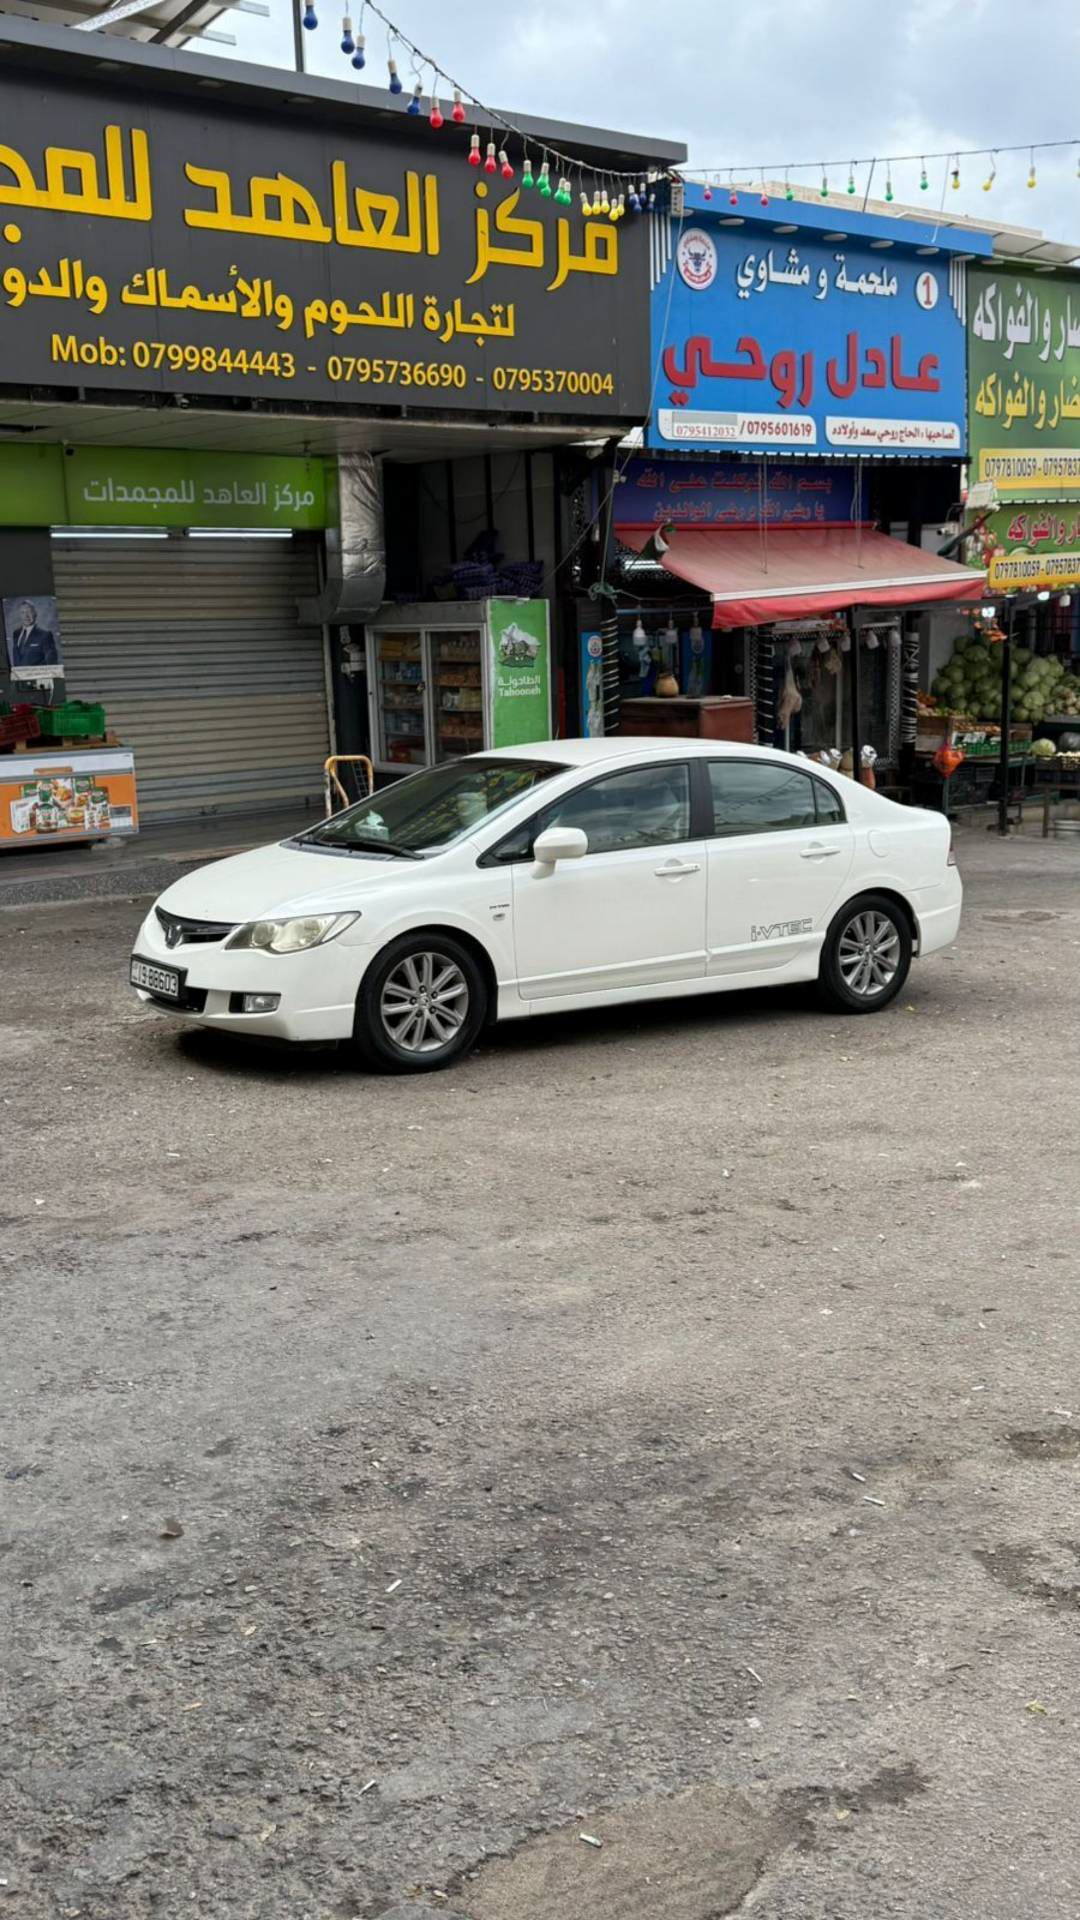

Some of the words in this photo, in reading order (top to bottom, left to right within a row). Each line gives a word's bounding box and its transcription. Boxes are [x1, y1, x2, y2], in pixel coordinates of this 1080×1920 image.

[184, 159, 440, 256] العاهد
[466, 181, 618, 292] مركز
[121, 264, 294, 331] والأسماك
[736, 247, 811, 299] مشاوي
[815, 266, 828, 300] و
[835, 252, 898, 297] ملحمة
[922, 275, 934, 306] 1
[303, 291, 415, 339] اللحوم
[423, 295, 515, 347] لتجارة
[51, 333, 126, 367] Mob:
[132, 340, 296, 379] 0799844443
[327, 355, 466, 388] 0795736690
[493, 366, 614, 395] 0795370004
[662, 332, 815, 409] روحي
[826, 329, 941, 399] عادل
[84, 478, 195, 509] للمجمدات
[202, 480, 267, 507] العاهد
[274, 484, 316, 511] مركز
